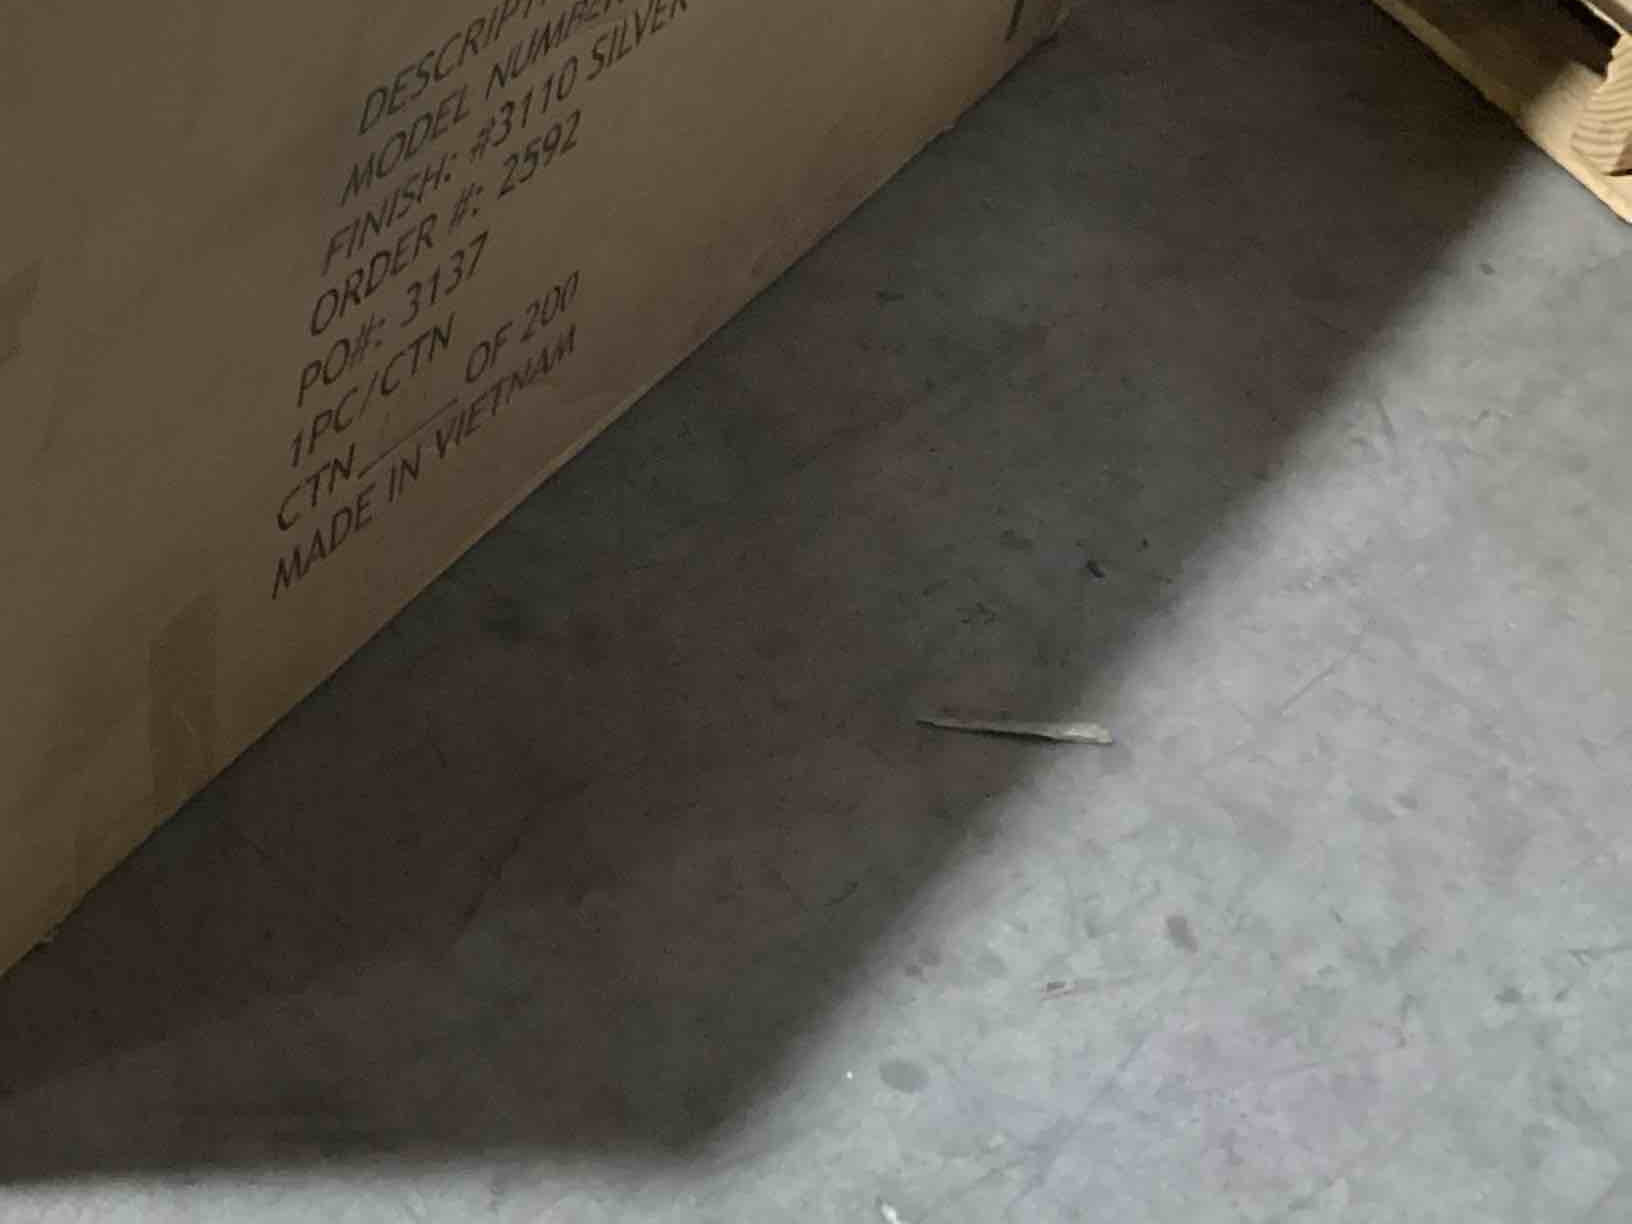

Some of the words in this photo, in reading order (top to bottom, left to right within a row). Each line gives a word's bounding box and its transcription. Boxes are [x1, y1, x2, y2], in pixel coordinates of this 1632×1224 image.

[311, 212, 438, 336] ORDER
[496, 108, 582, 201] 2592
[321, 151, 458, 276] FINISH:
[469, 55, 580, 165] #3110
[337, 84, 469, 209] MODEL
[289, 311, 456, 468] 1PC/CTN
[297, 313, 387, 408] PO#:
[399, 230, 490, 327] 3137
[464, 320, 514, 385] OF
[271, 482, 376, 601] MADE
[388, 442, 422, 504] IN
[435, 323, 577, 460] VIETNAM
